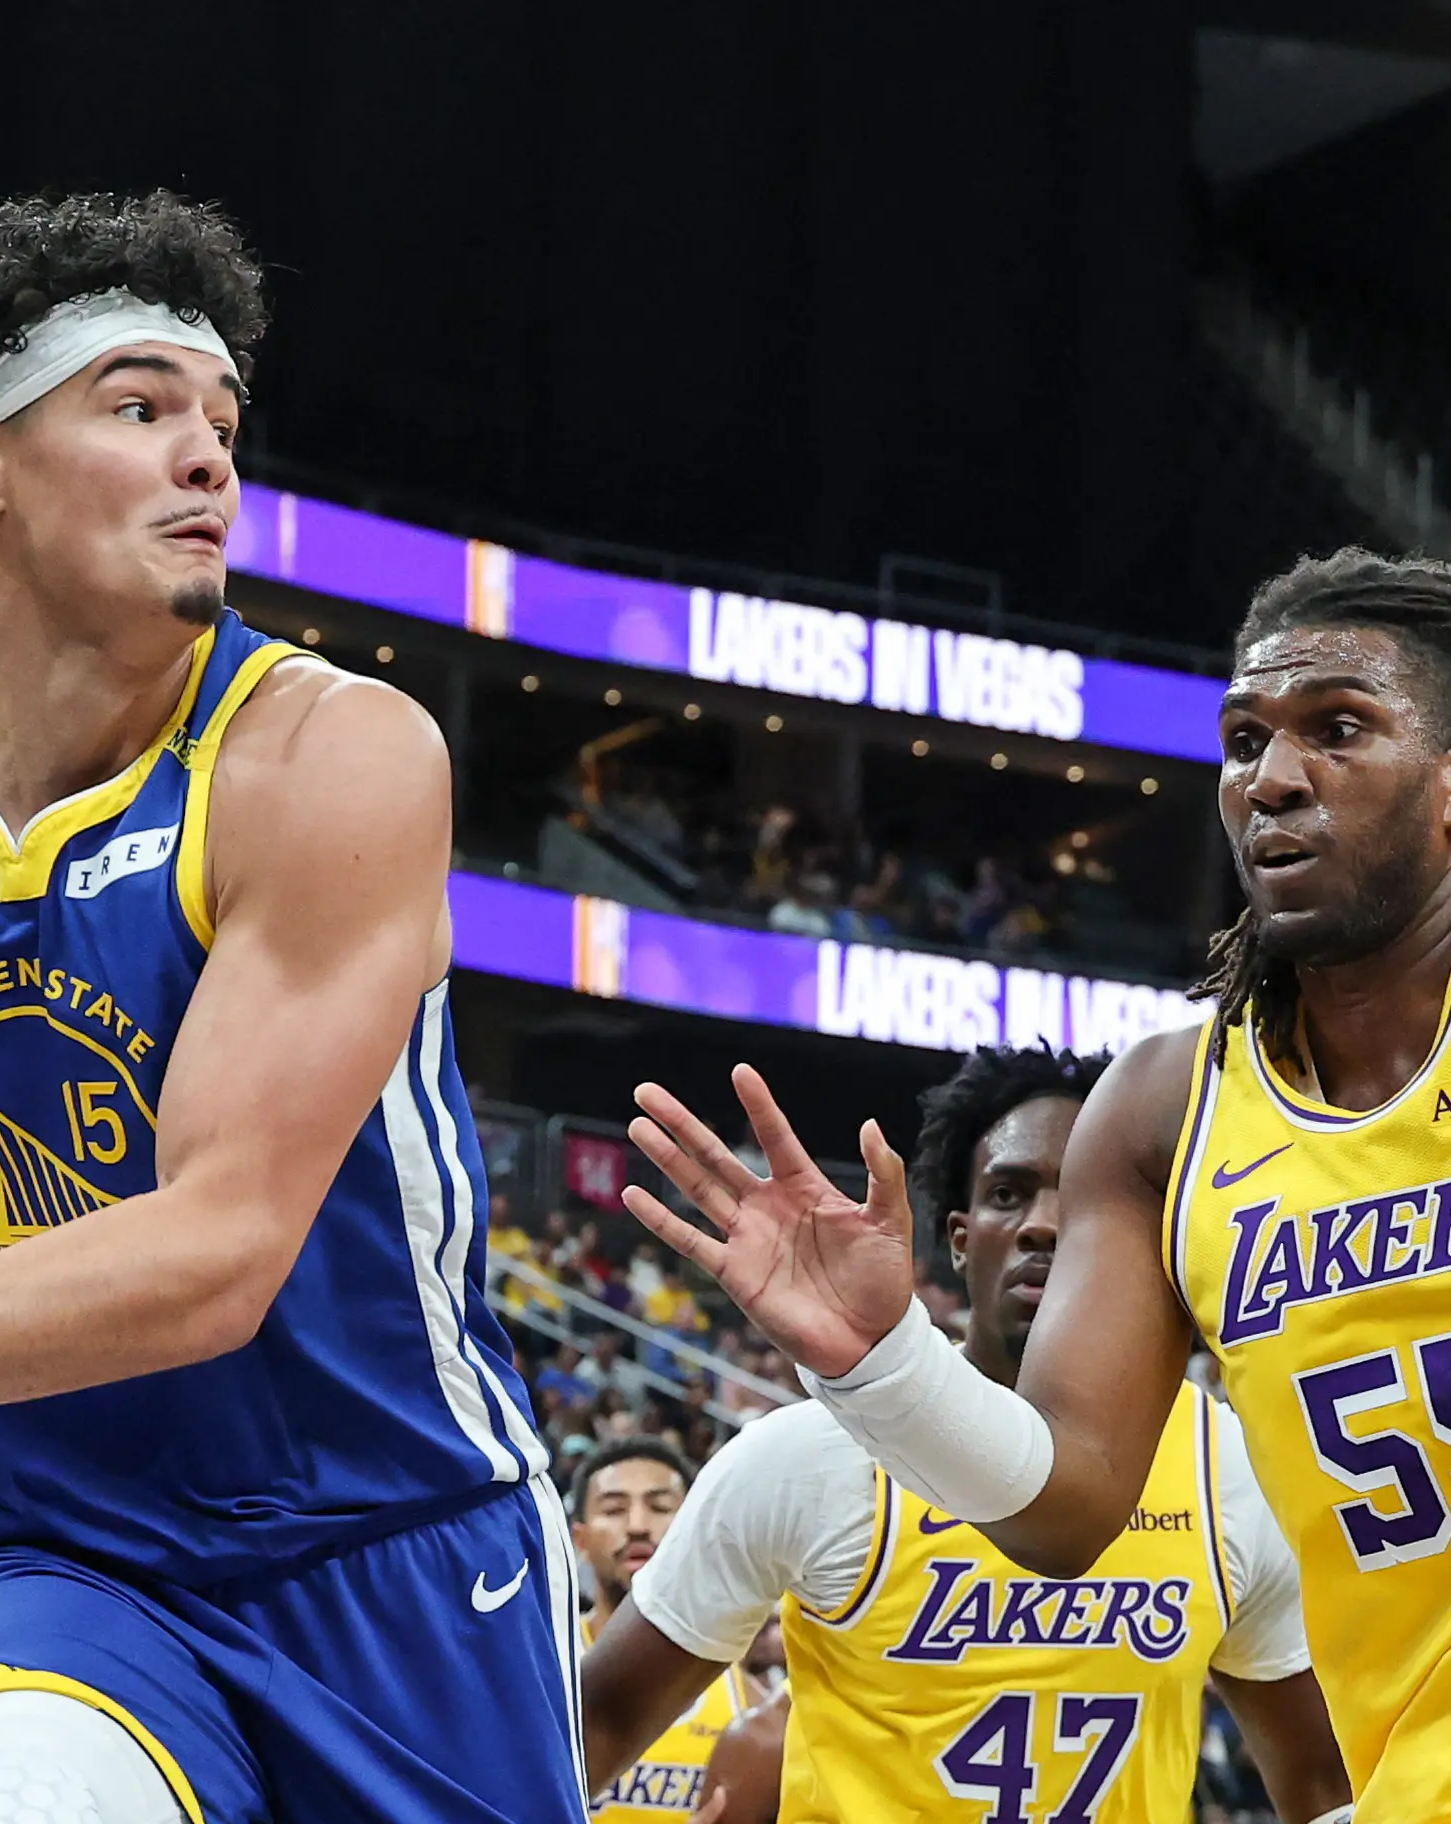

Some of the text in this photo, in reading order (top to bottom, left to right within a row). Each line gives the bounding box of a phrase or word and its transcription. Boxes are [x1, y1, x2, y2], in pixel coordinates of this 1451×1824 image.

[690, 586, 1085, 740] LAKERS IN VEGAS
[79, 835, 172, 892] IREN
[45, 968, 156, 1064] STATE
[817, 938, 1001, 1052] LAKERS
[62, 1080, 127, 1165] 15
[880, 1556, 1193, 1666] LAKERS
